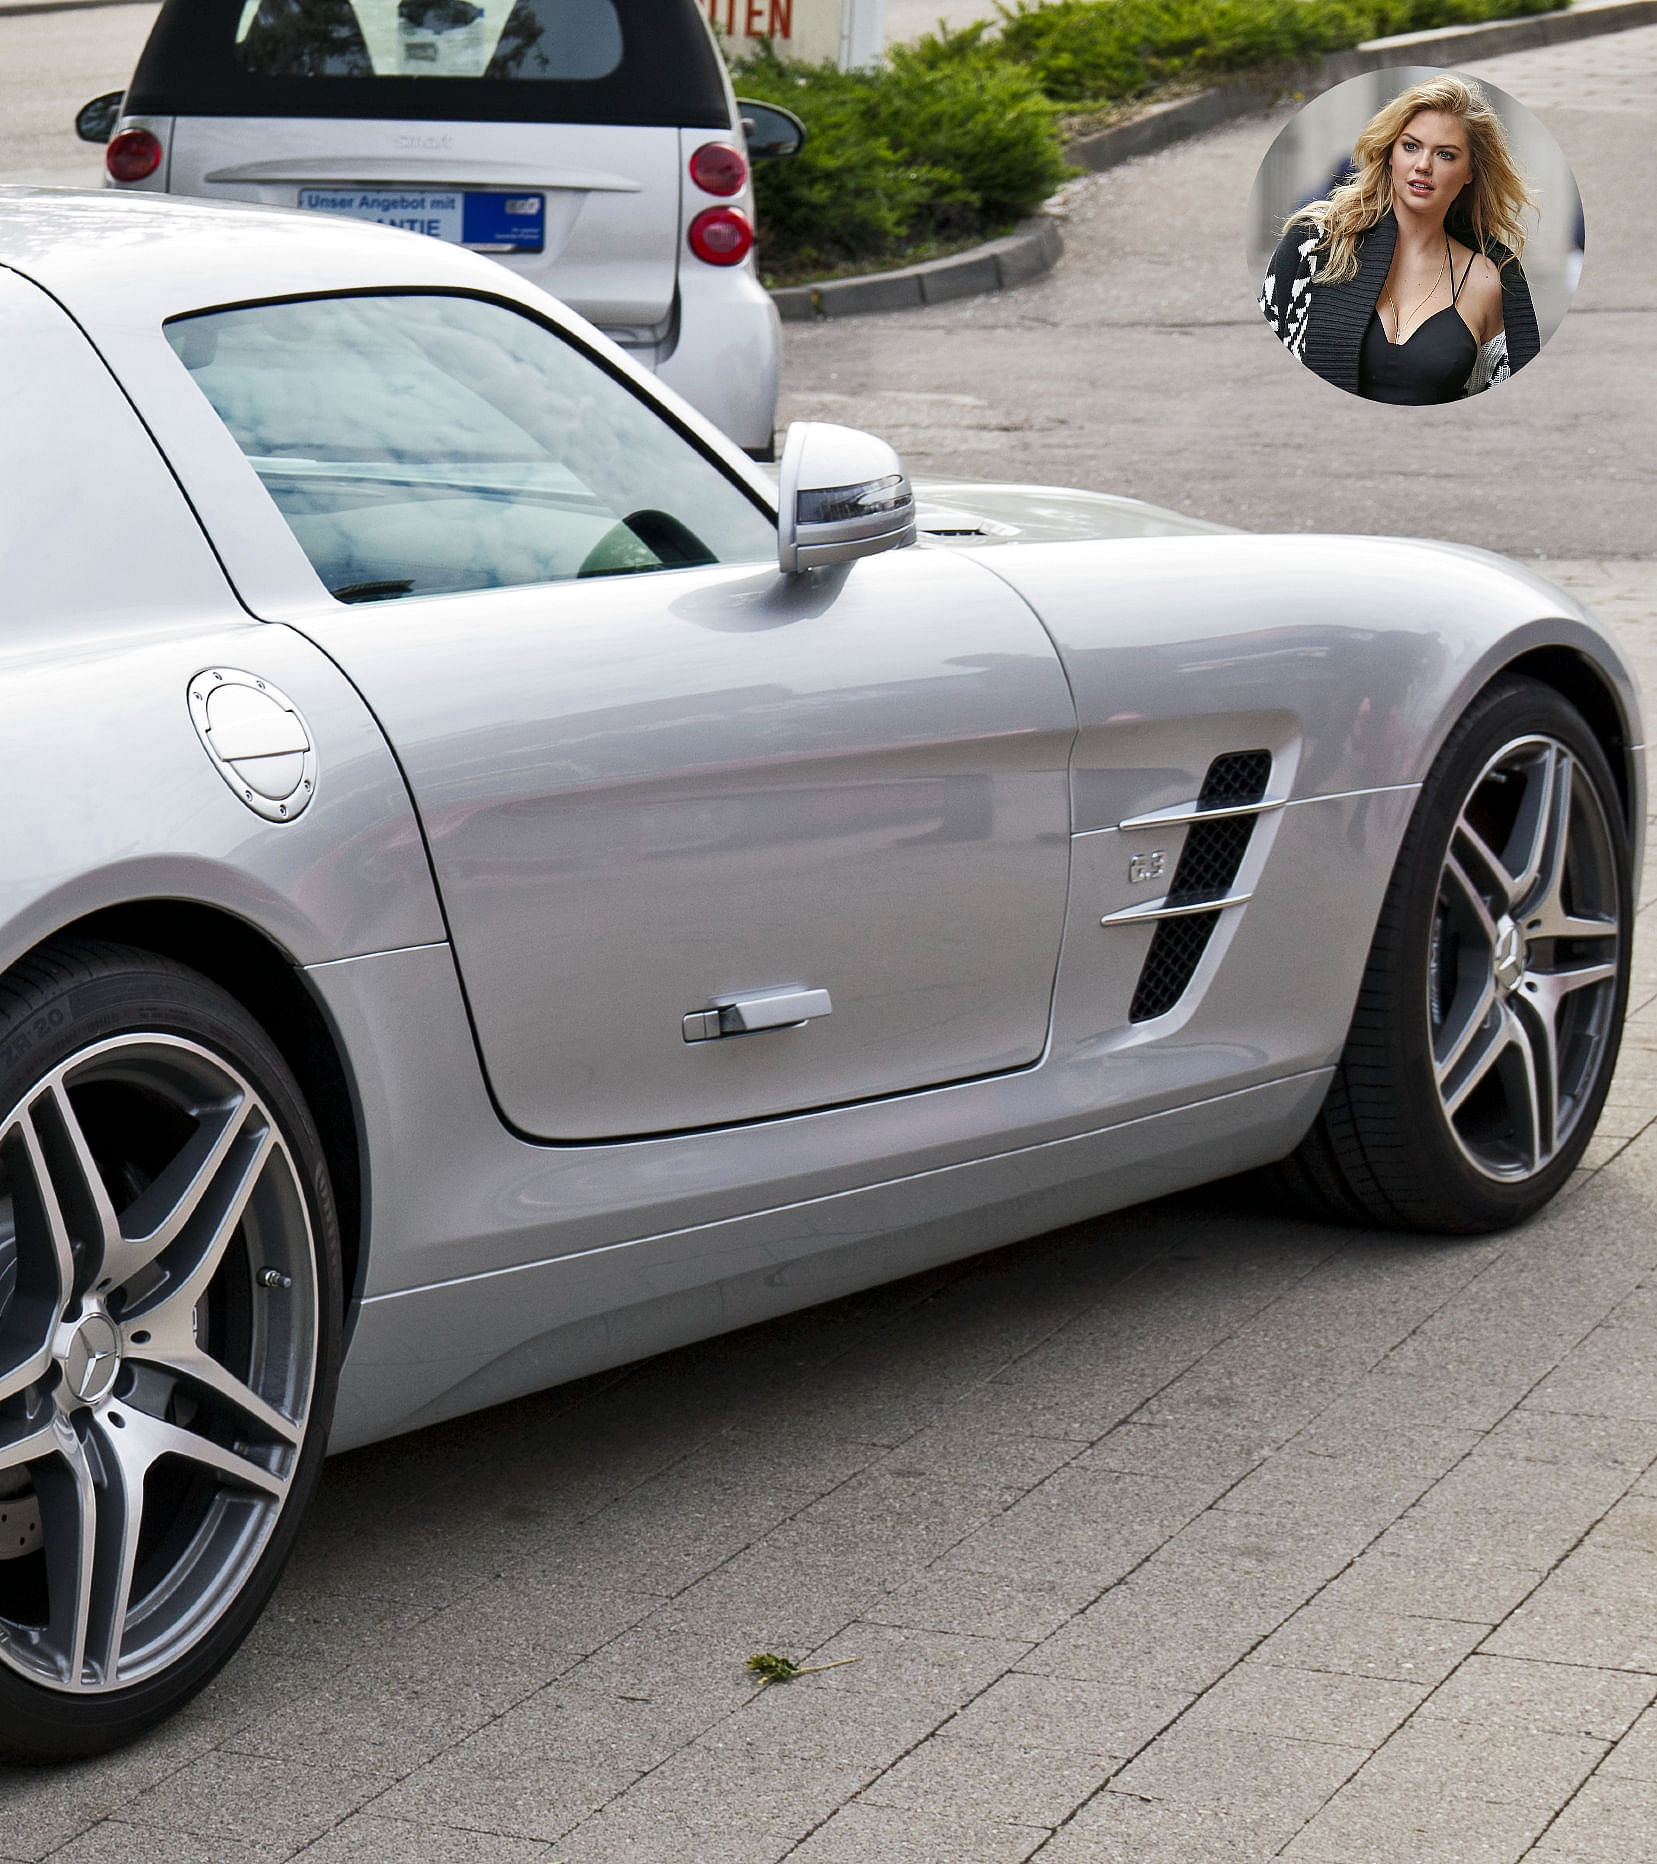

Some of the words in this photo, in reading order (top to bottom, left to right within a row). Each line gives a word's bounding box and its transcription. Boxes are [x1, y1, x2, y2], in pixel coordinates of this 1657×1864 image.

[307, 194, 354, 208] Unser
[358, 196, 426, 212] Angebot
[430, 196, 456, 210] mit
